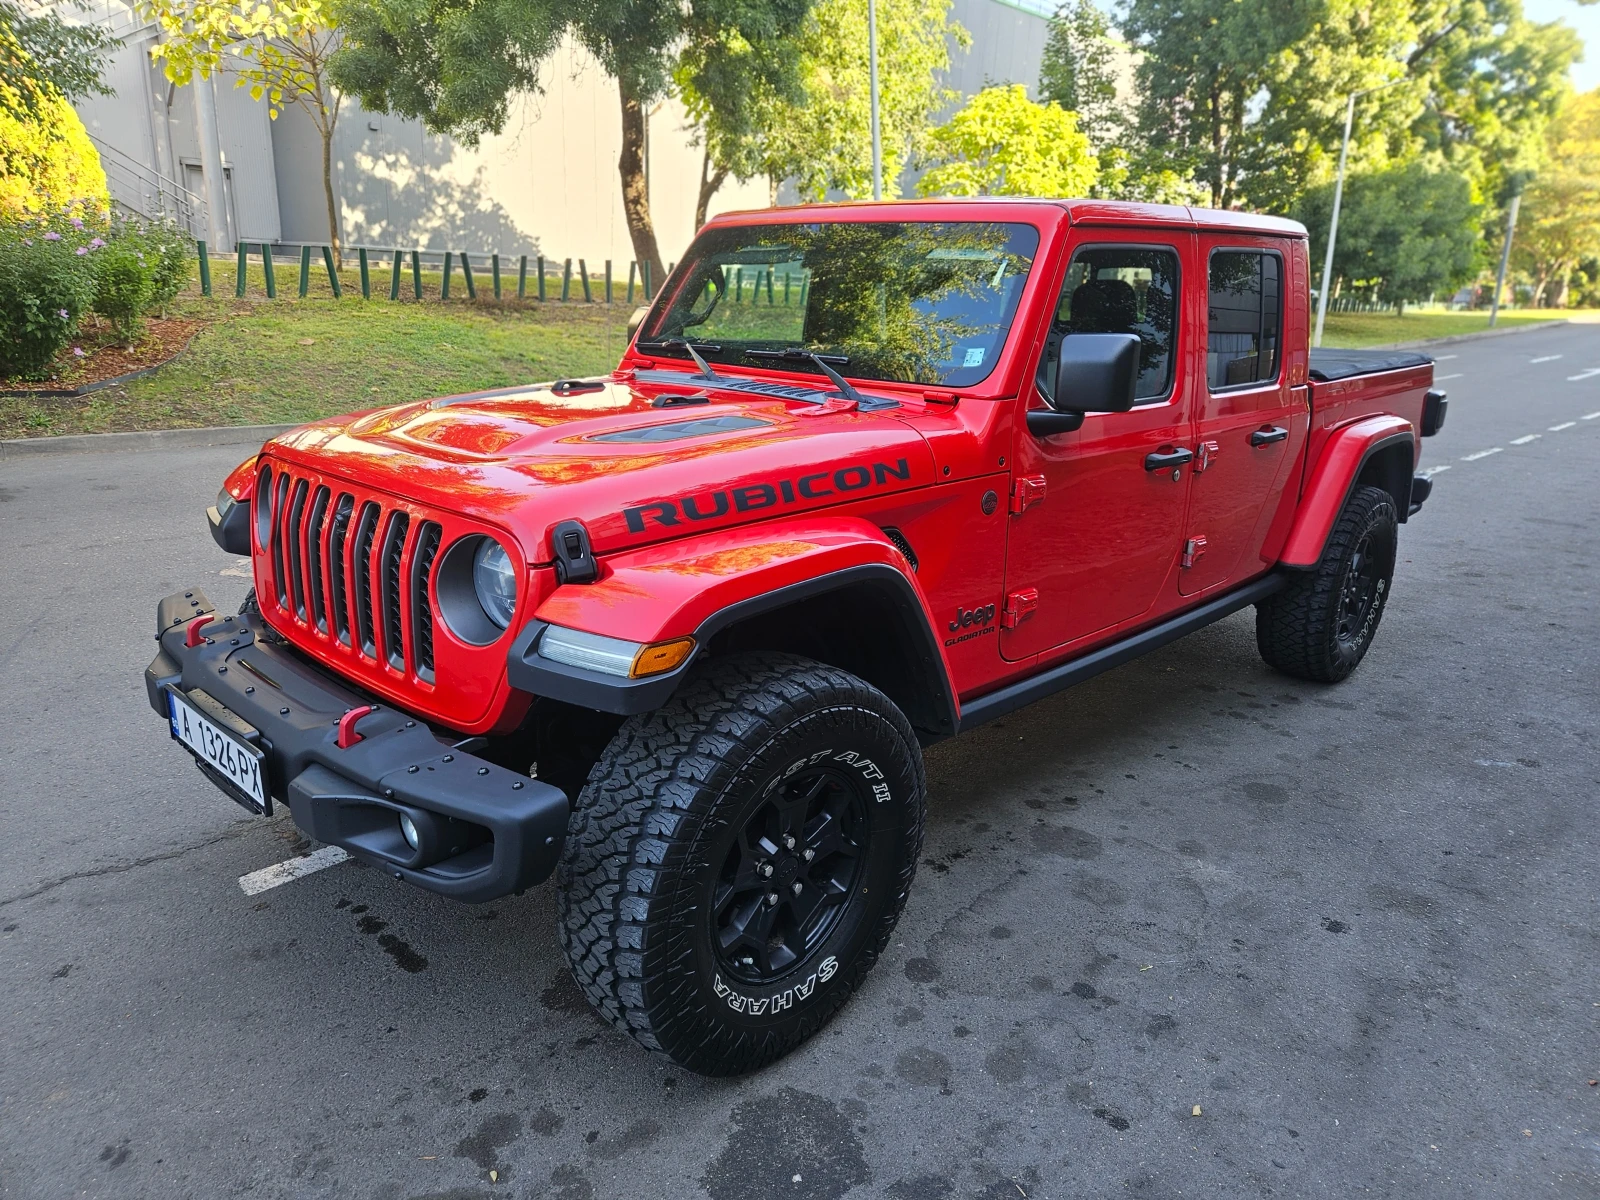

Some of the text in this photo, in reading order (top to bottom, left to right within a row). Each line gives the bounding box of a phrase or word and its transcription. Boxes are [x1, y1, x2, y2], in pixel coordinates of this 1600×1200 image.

[622, 457, 912, 535] RUBICON
[944, 625, 995, 647] GLADIATOR
[948, 603, 996, 632] Jeep
[182, 706, 194, 743] A
[712, 955, 839, 1016] SAHARA
